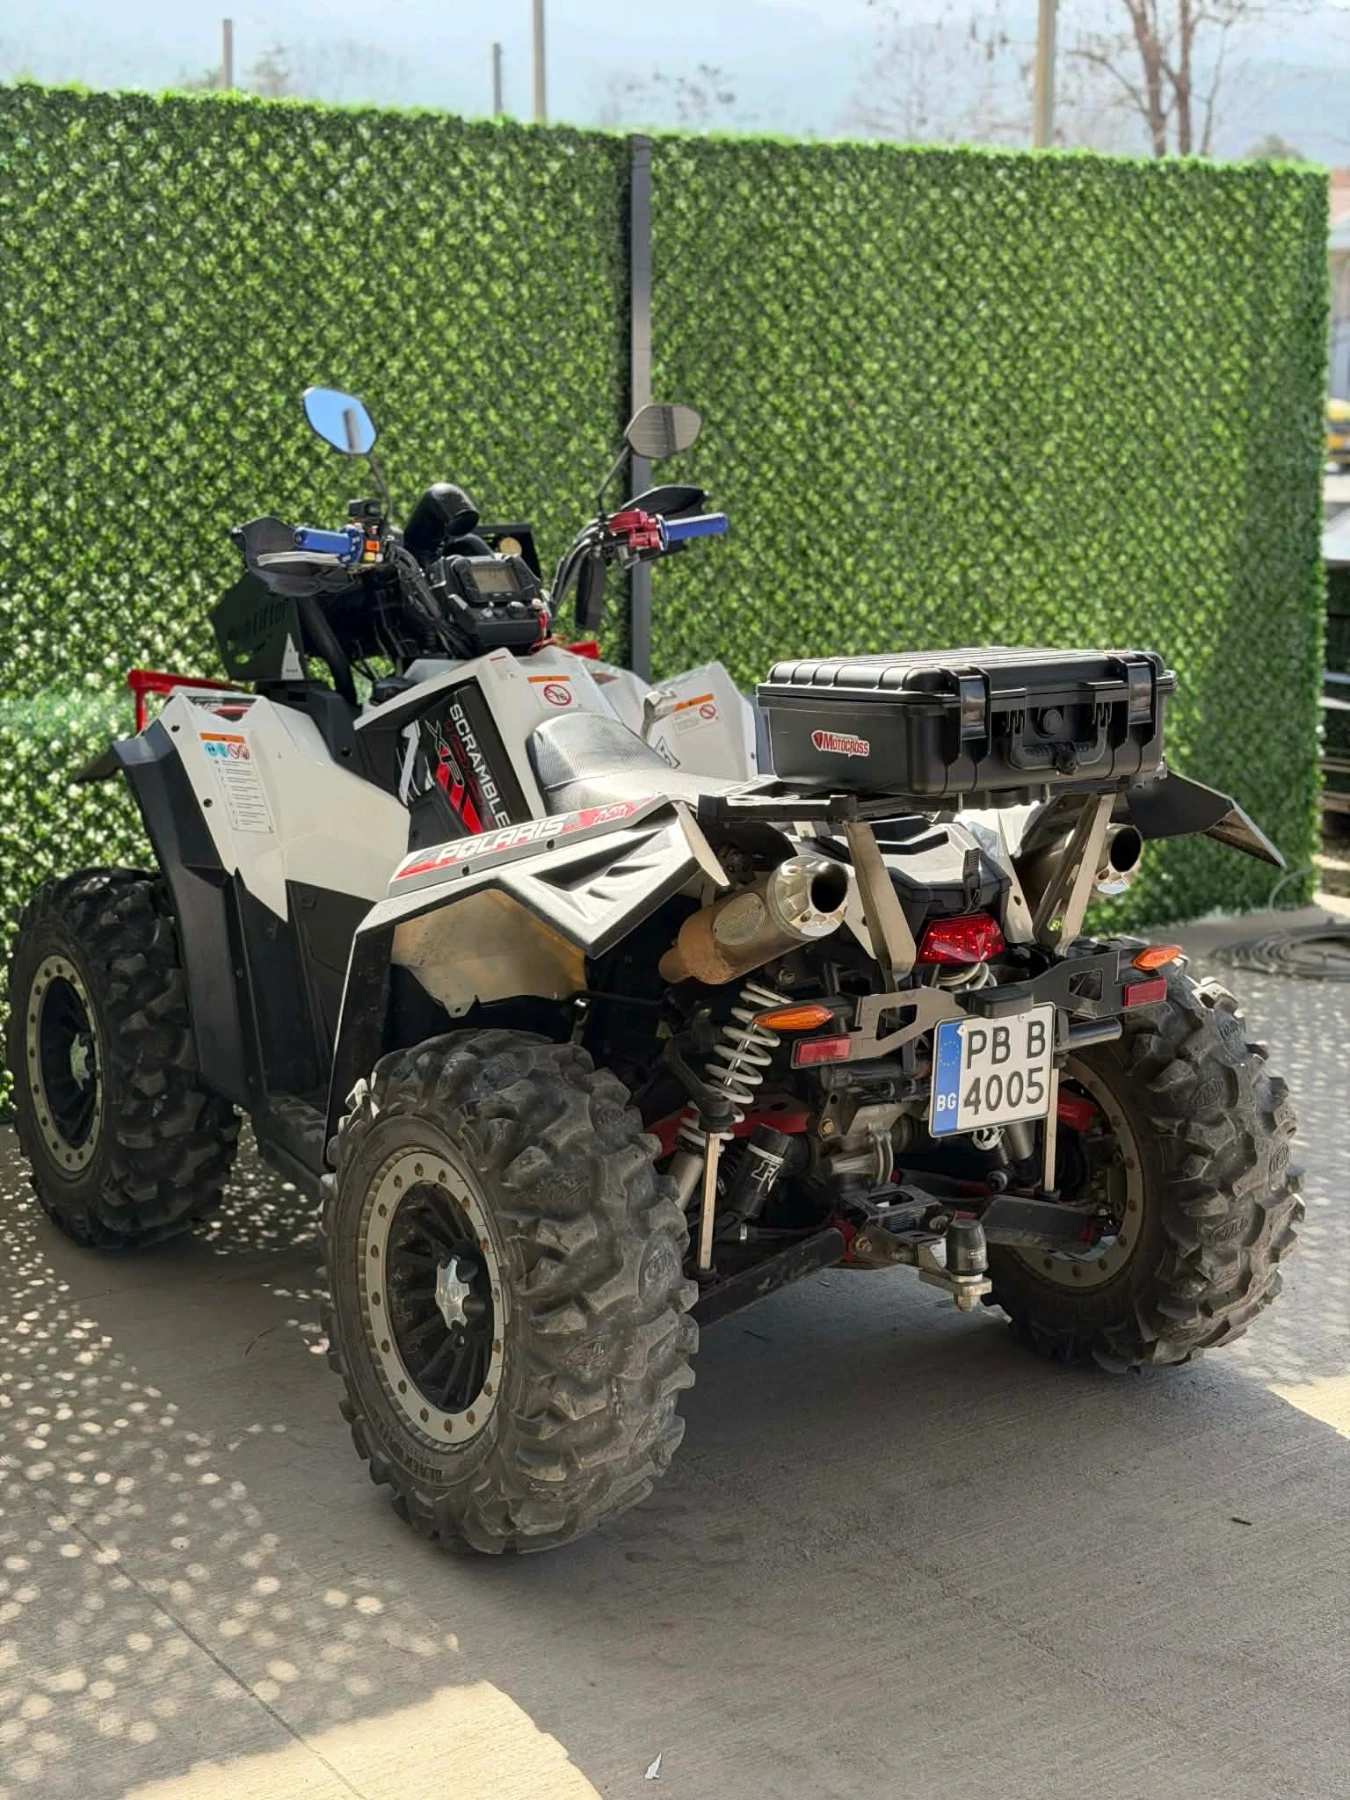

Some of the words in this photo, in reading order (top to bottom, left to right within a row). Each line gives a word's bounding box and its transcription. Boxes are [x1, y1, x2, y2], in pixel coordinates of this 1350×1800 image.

[436, 815, 569, 864] POLARIS
[966, 1025, 1011, 1070] PB
[1026, 1020, 1046, 1060] B
[936, 1092, 957, 1112] BG
[963, 1066, 1044, 1115] 4005
